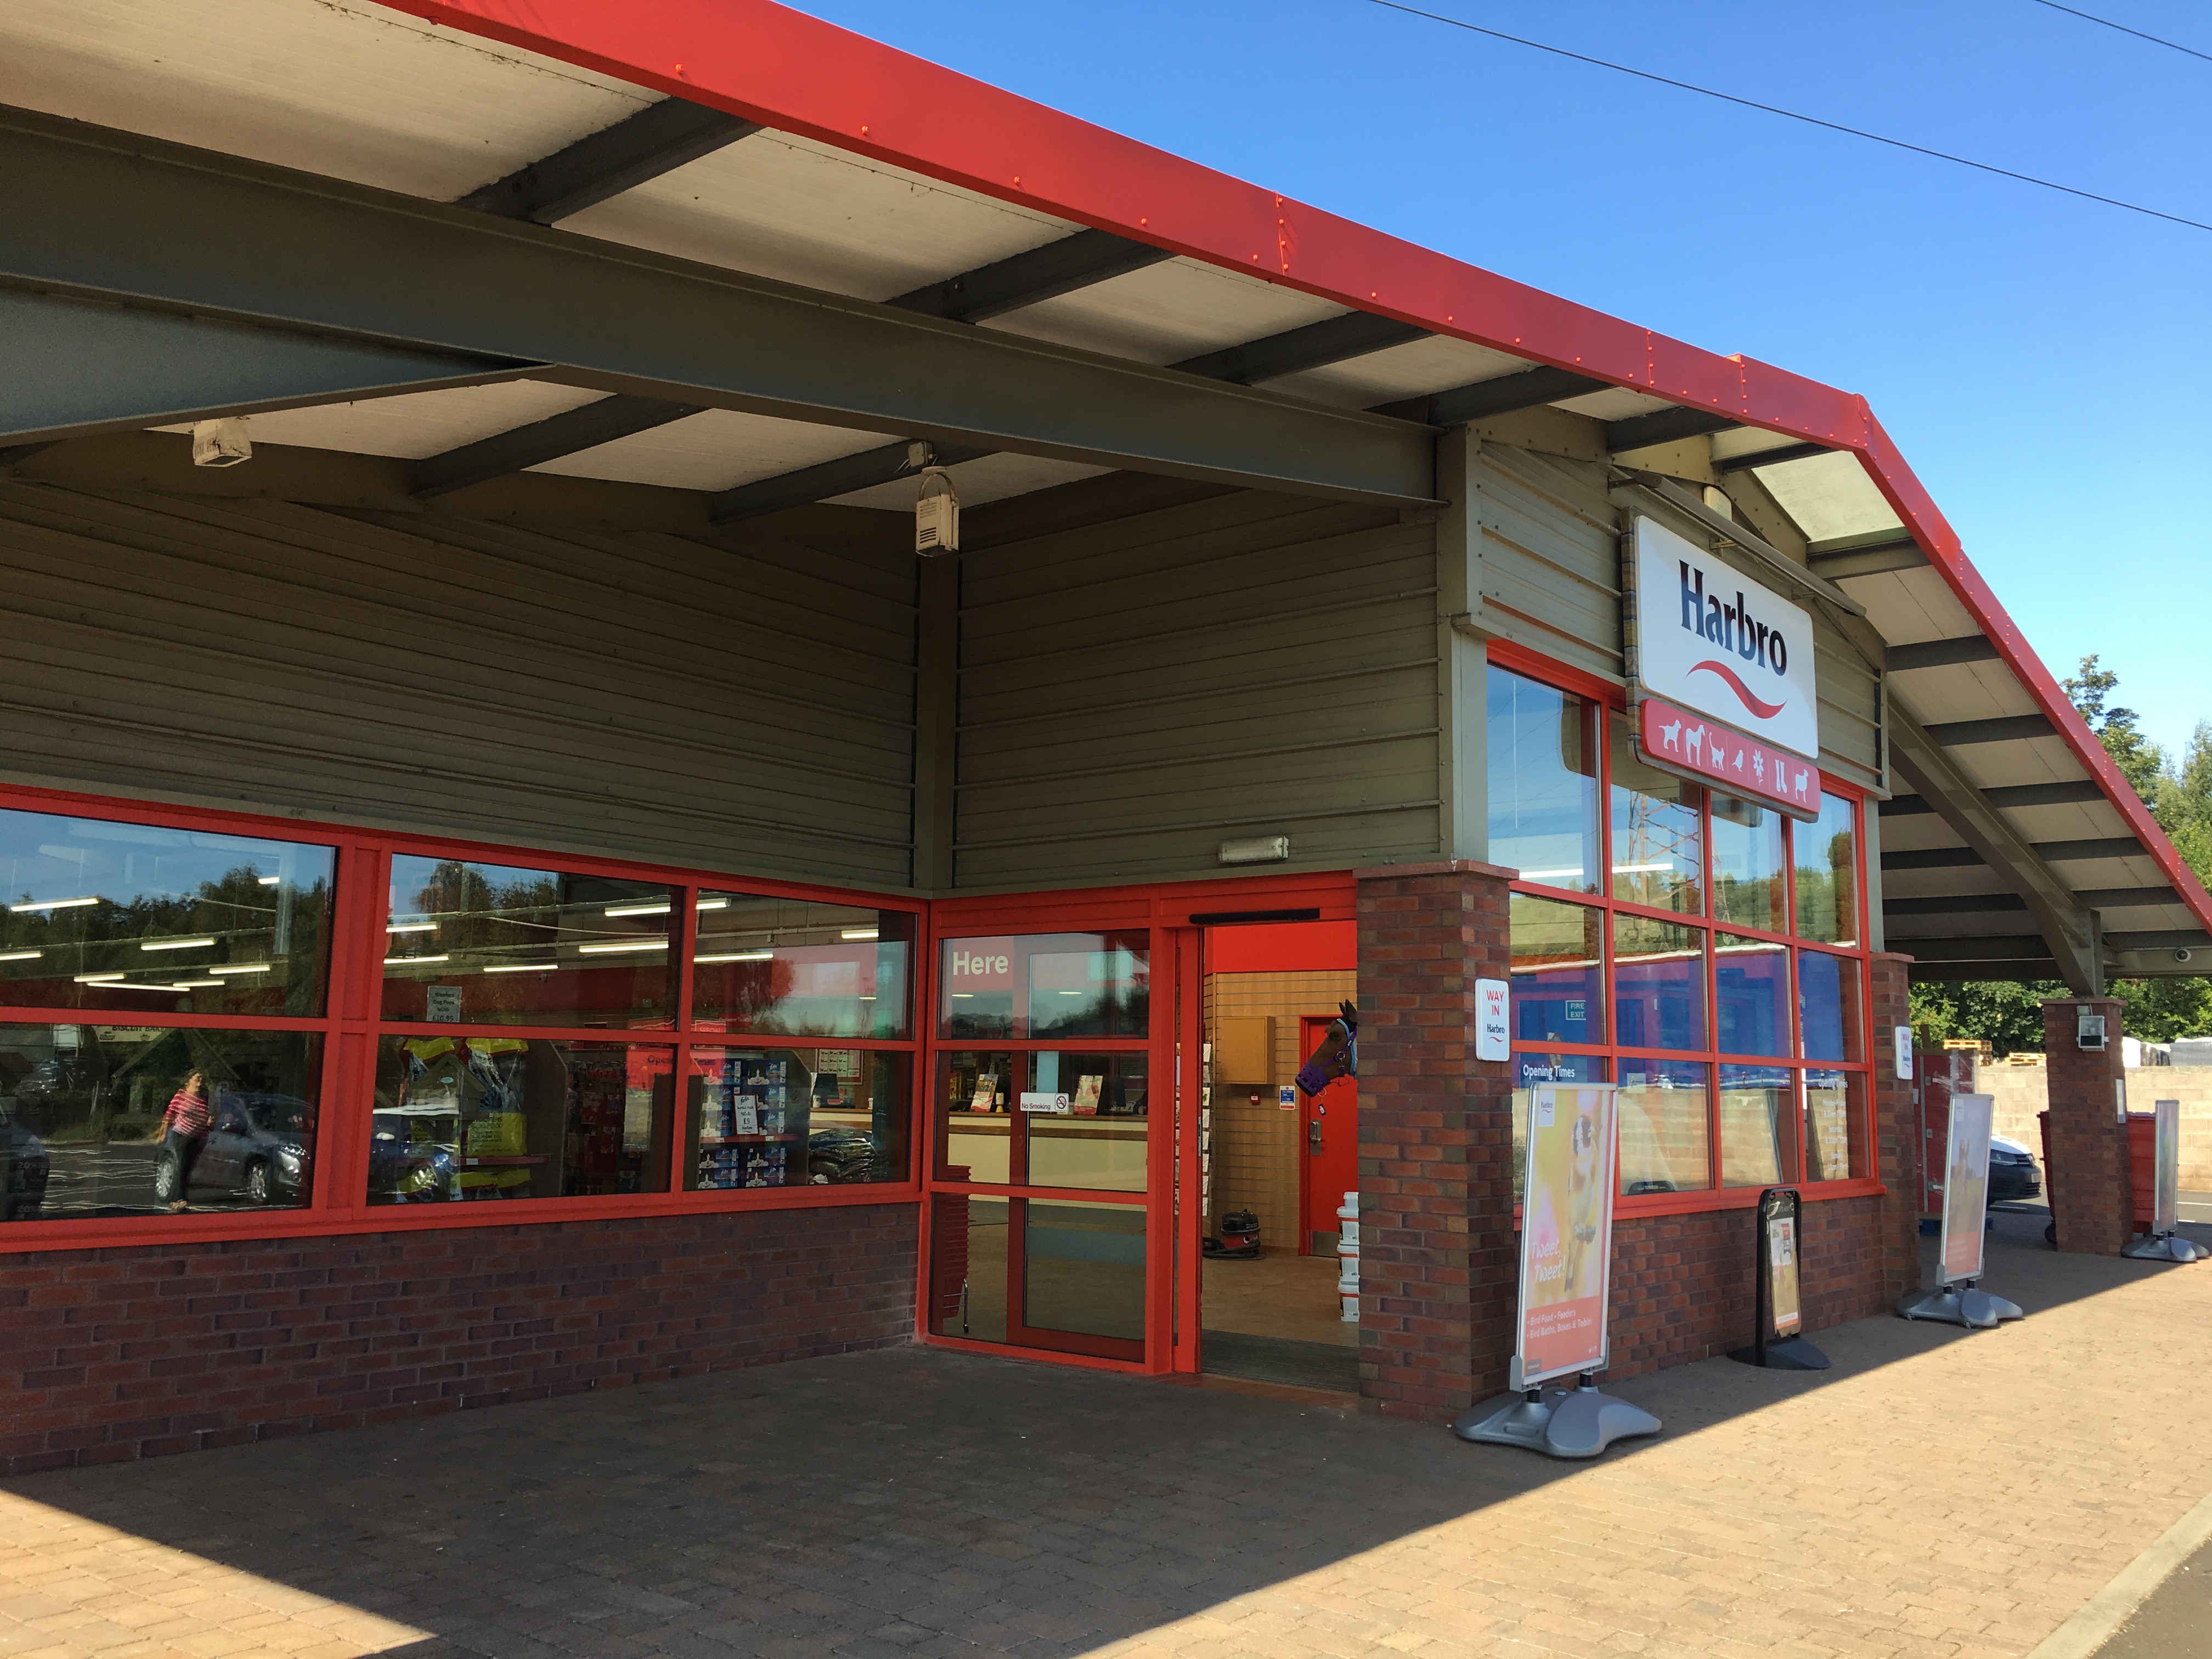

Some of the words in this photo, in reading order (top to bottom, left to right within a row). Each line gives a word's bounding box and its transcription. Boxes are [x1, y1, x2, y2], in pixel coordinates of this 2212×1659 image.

[1679, 559, 1787, 676] Harbro
[953, 951, 1008, 975] Here
[1486, 990, 1504, 1002] WAY
[1492, 1005, 1499, 1016] IN
[1487, 1024, 1505, 1034] Harbro
[1523, 1064, 1553, 1081] Opening
[1554, 1065, 1575, 1077] Times
[1531, 1237, 1561, 1260] Tweet,
[1534, 1255, 1566, 1283] Tweet!
[1531, 1315, 1541, 1325] Bird
[1542, 1312, 1554, 1323] Food
[1558, 1309, 1576, 1320] Feeders
[1530, 1328, 1540, 1339] Bird
[1541, 1325, 1556, 1336] Baths,
[1557, 1322, 1572, 1332] Boxes
